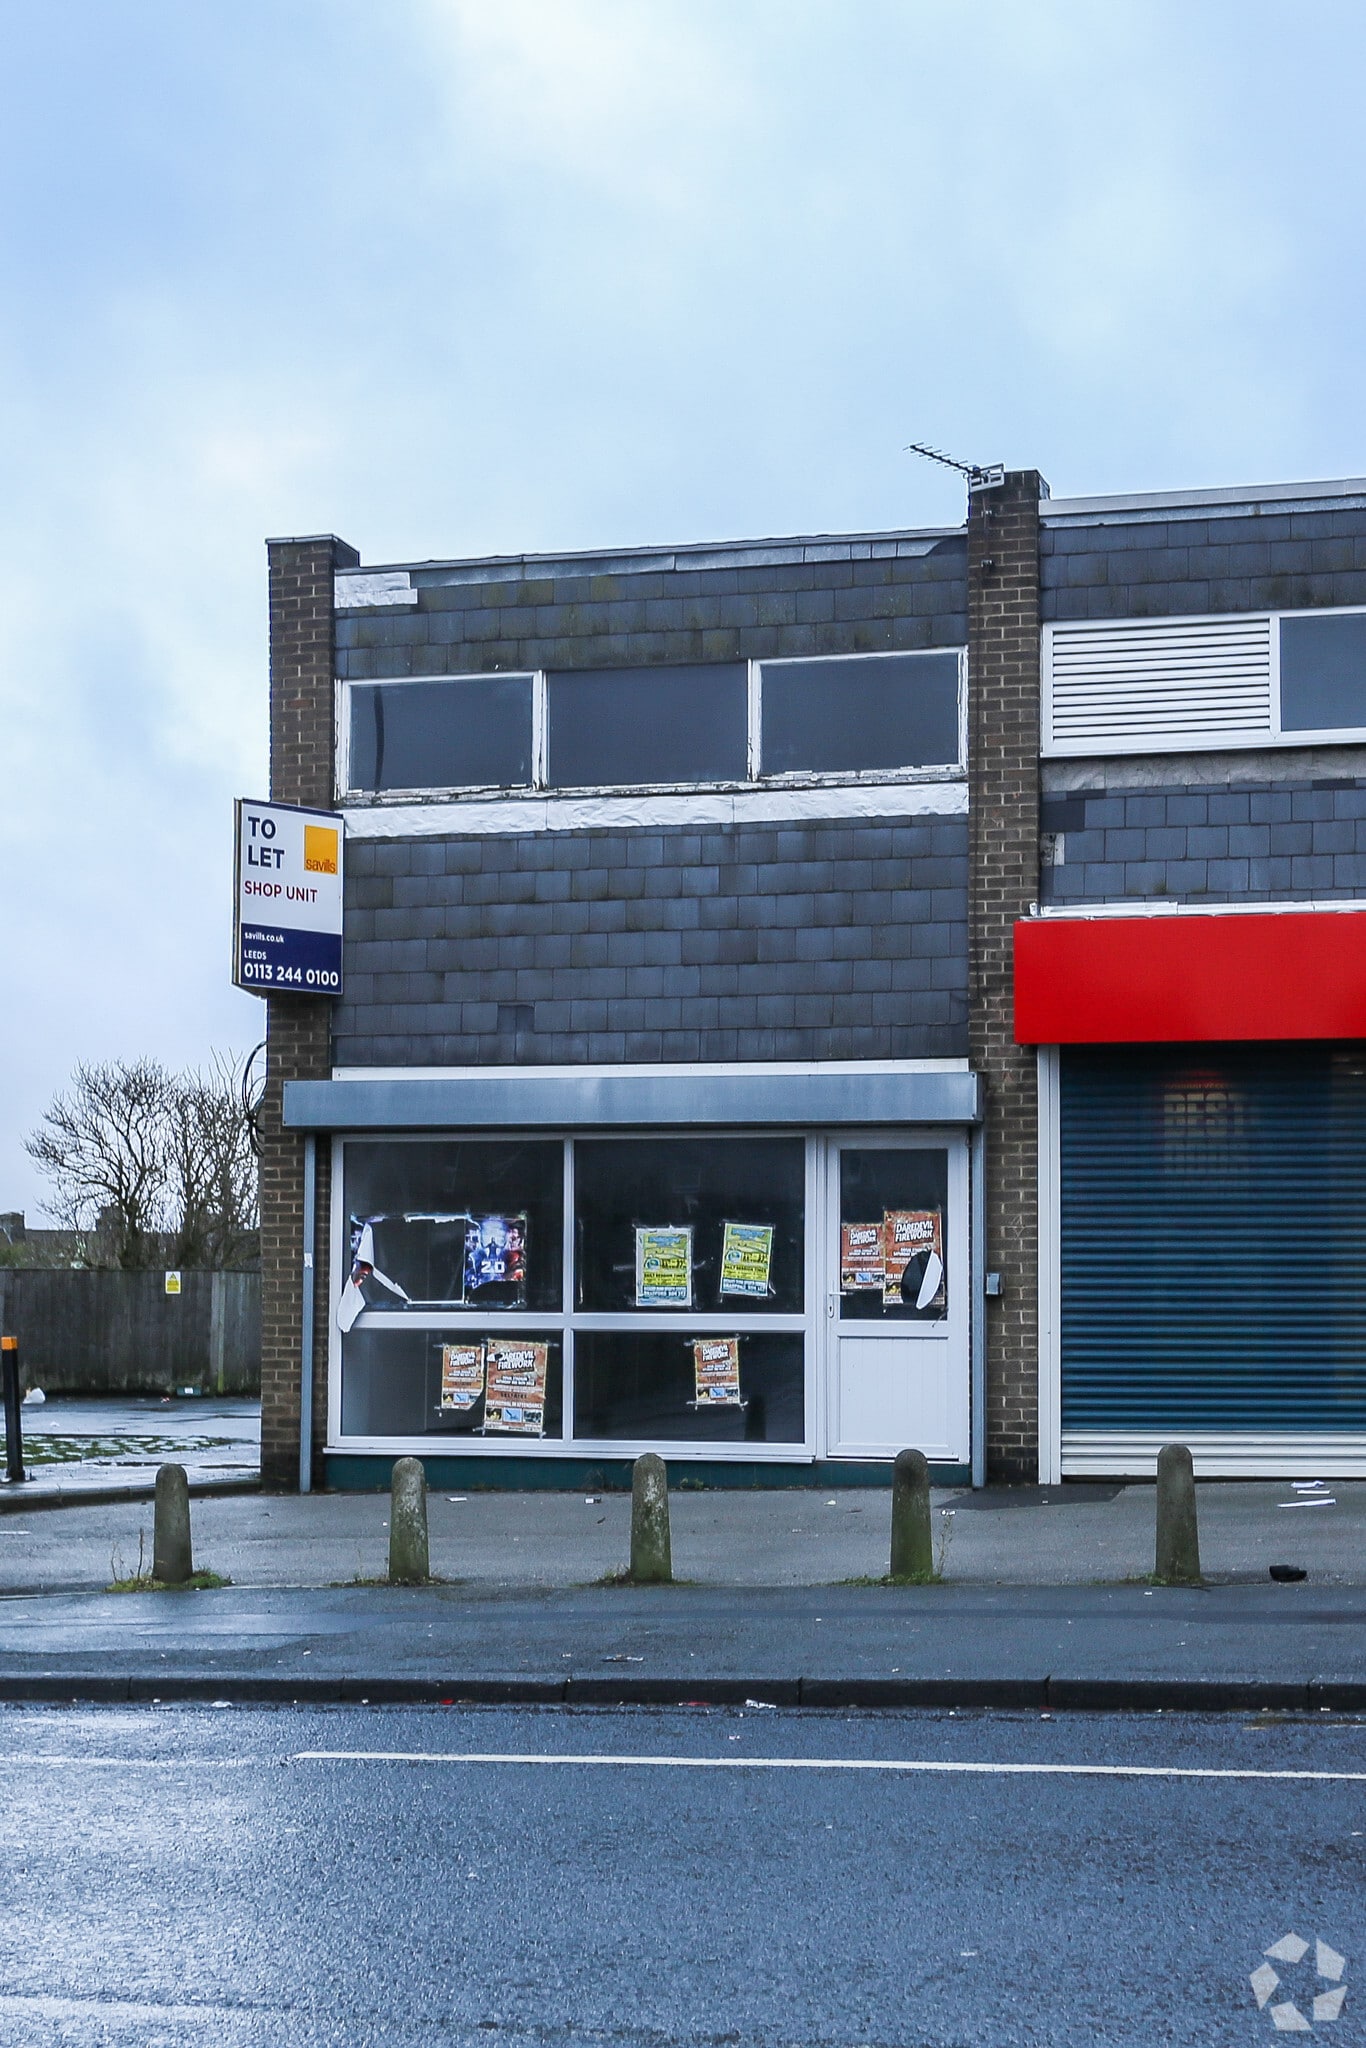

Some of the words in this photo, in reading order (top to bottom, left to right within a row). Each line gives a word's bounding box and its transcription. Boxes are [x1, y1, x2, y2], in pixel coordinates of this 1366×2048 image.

[248, 816, 276, 840] TO
[248, 844, 285, 869] LET
[305, 858, 336, 874] savills
[244, 880, 282, 898] SHOP
[286, 885, 318, 903] UNIT
[244, 931, 285, 943] savills.co.uk
[243, 949, 267, 960] LEEDS
[244, 962, 273, 980] 0113
[276, 965, 303, 983] 244
[306, 969, 339, 986] 0100
[896, 1221, 934, 1233] DAREDEVIL
[895, 1230, 933, 1242] FIREWORK
[497, 1359, 534, 1370] FIREWORK
